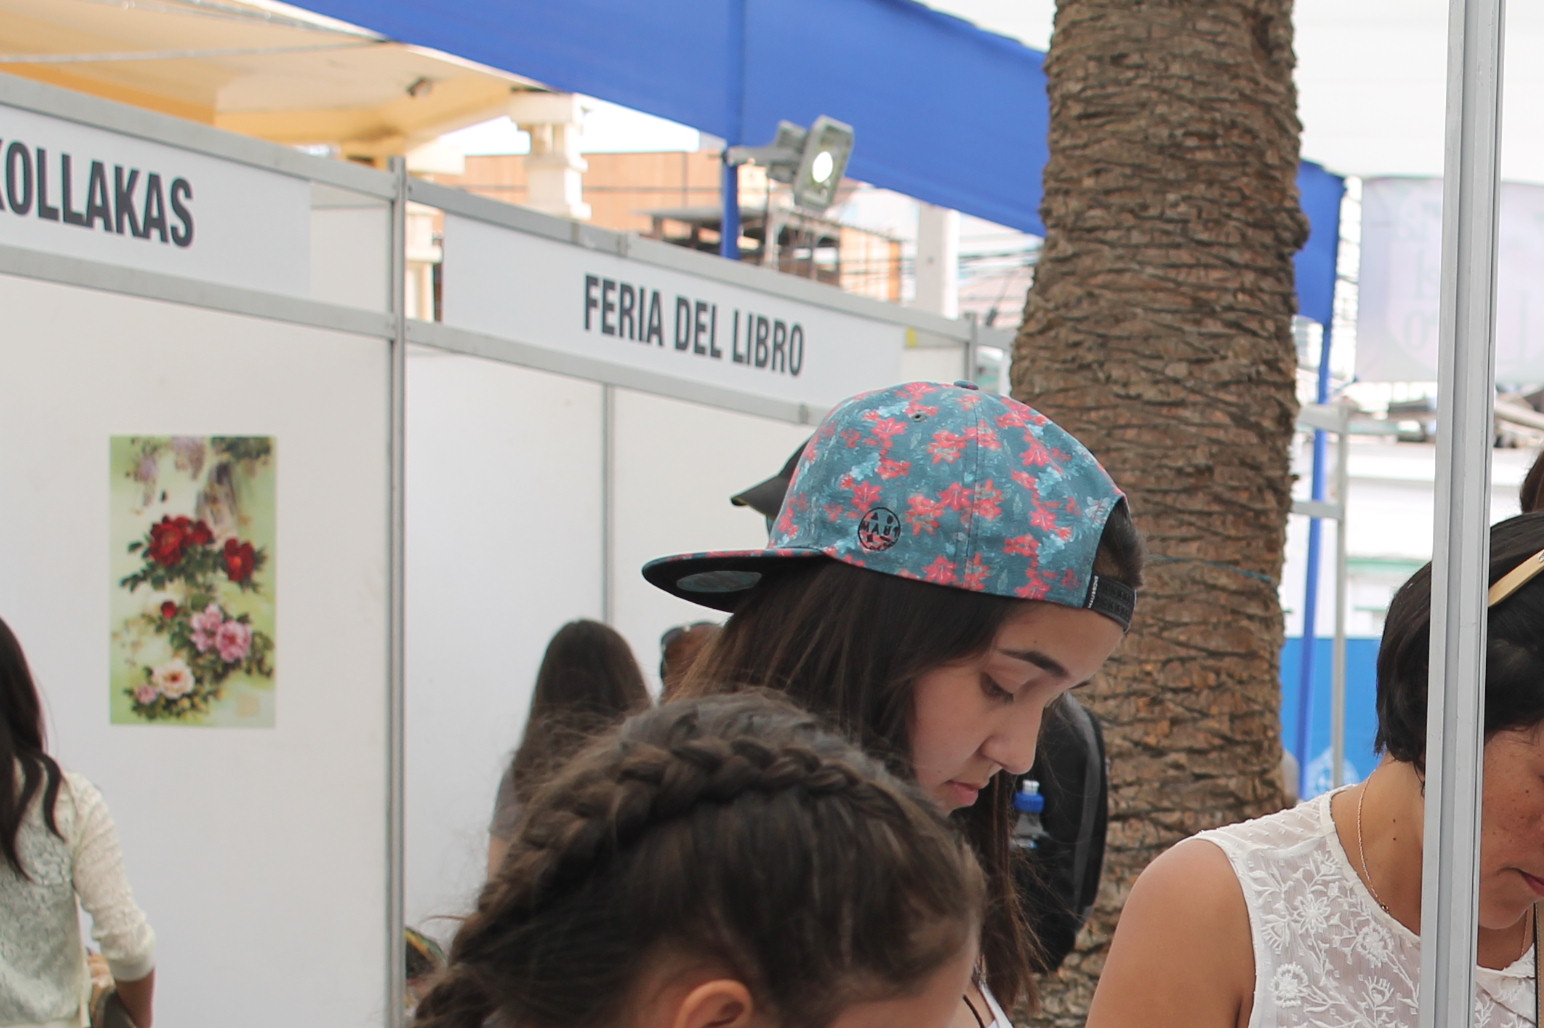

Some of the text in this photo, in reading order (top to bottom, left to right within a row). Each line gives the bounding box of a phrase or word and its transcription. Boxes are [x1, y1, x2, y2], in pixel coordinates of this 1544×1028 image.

[0, 138, 195, 248] OLLAKAS
[584, 273, 804, 377] FERIA DEL LIBRO
